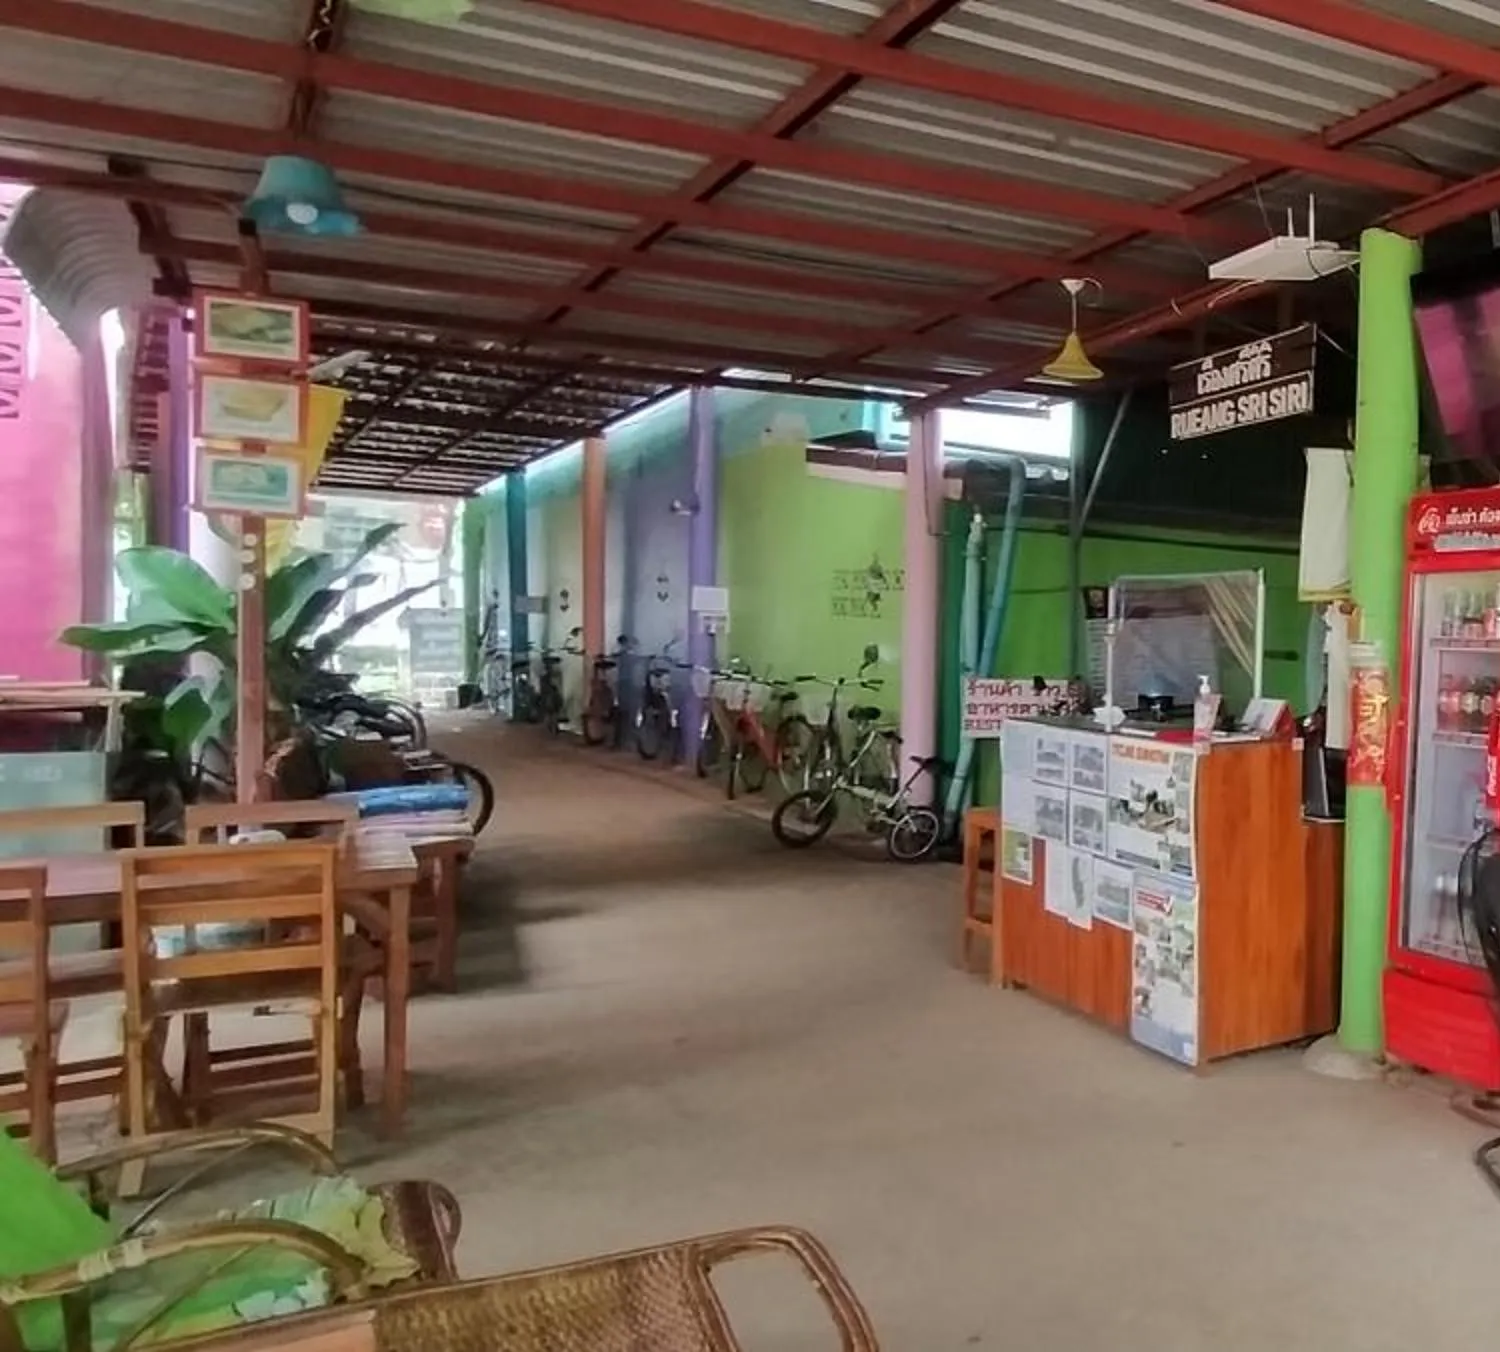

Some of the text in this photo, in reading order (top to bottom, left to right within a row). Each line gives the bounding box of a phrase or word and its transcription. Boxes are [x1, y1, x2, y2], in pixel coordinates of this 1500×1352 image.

[1171, 381, 1309, 439] RUEANG SRI SIRI
